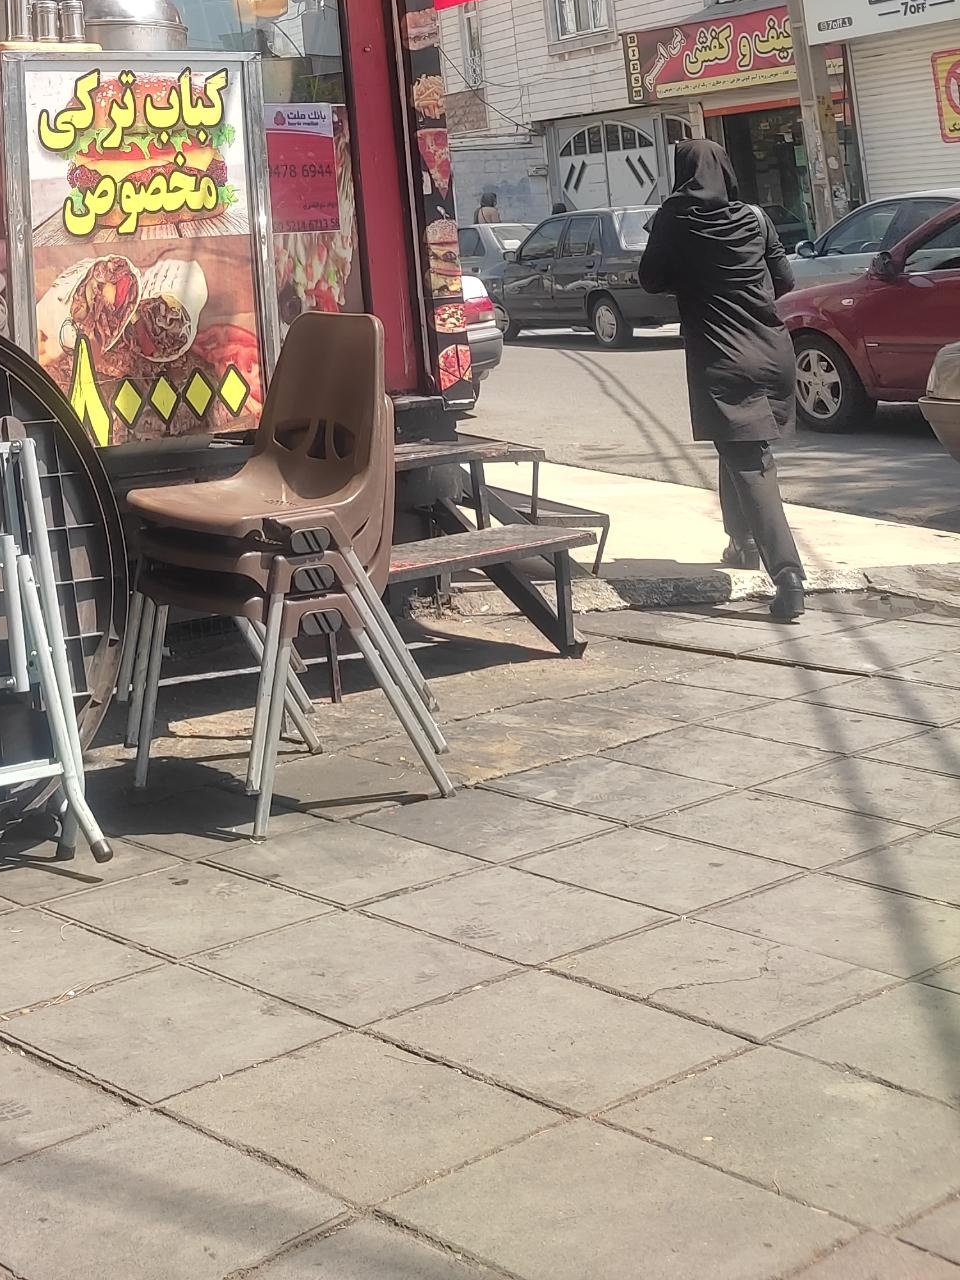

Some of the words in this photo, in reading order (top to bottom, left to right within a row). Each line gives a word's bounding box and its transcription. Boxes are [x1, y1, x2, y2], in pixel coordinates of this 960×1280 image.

[684, 22, 733, 76] کفش
[737, 36, 752, 68] و
[38, 68, 136, 151] ترکی
[142, 67, 228, 145] کباب
[287, 110, 306, 120] ملت
[63, 152, 218, 237] مخصوص
[302, 164, 333, 178] 6944
